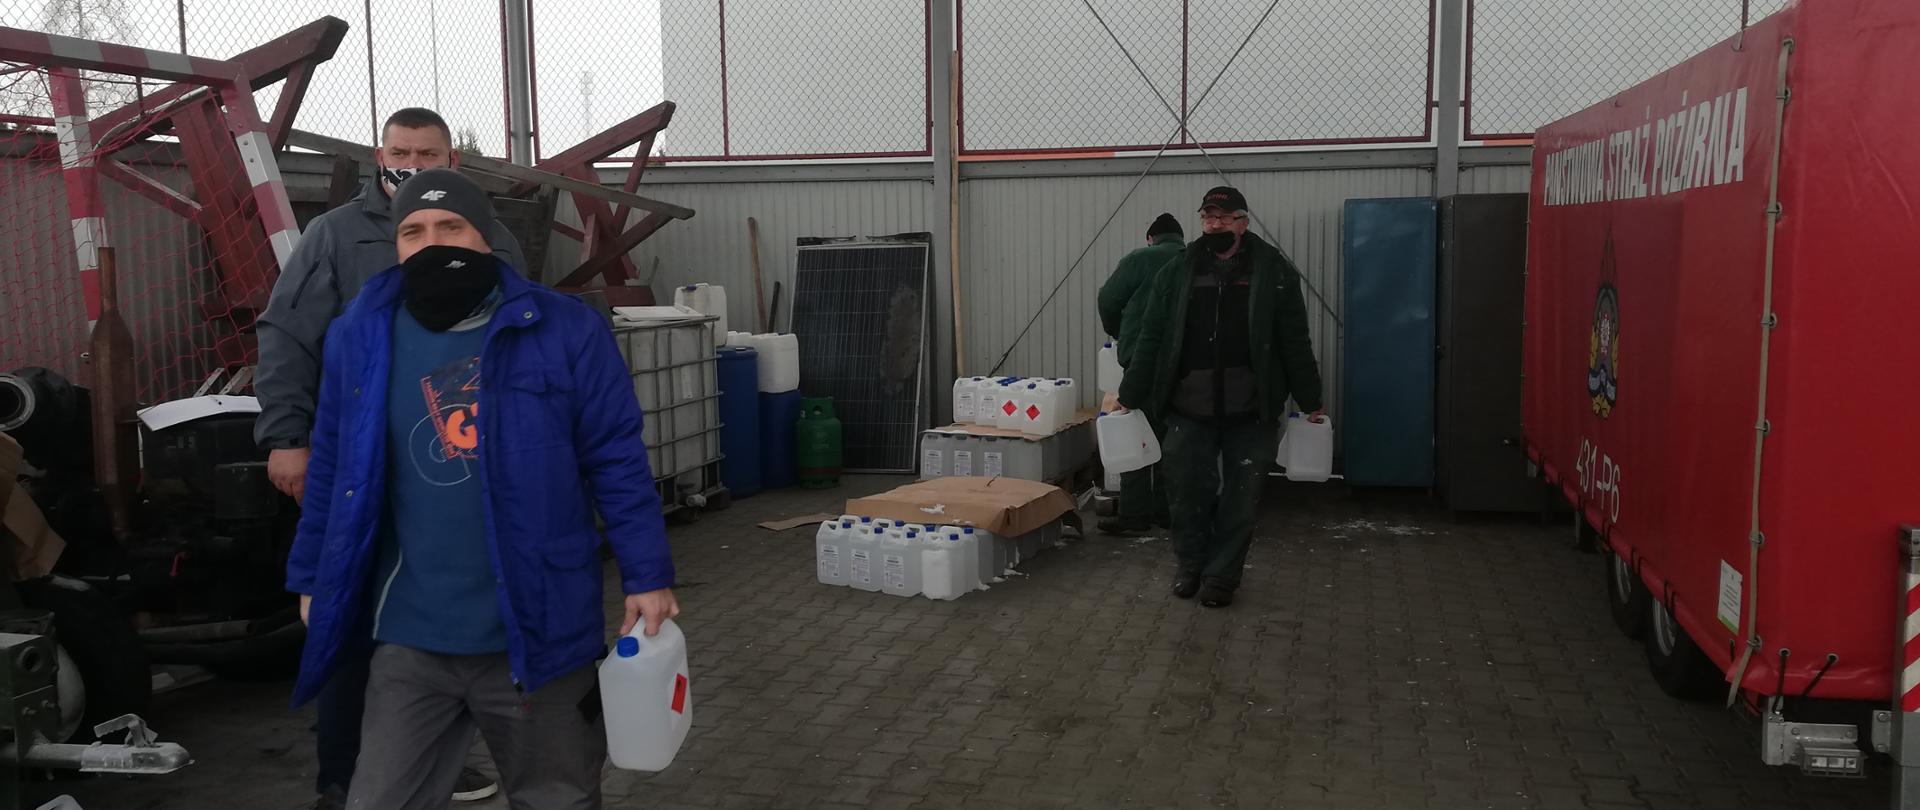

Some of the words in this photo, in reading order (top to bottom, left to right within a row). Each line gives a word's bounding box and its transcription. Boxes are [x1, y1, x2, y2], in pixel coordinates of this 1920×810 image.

[1543, 137, 1605, 206] PAŃSTWOWA
[1606, 105, 1651, 202] STRAŻ
[1651, 87, 1748, 197] POŻARNA
[420, 189, 448, 202] 4F
[1575, 435, 1621, 524] 431-P6
